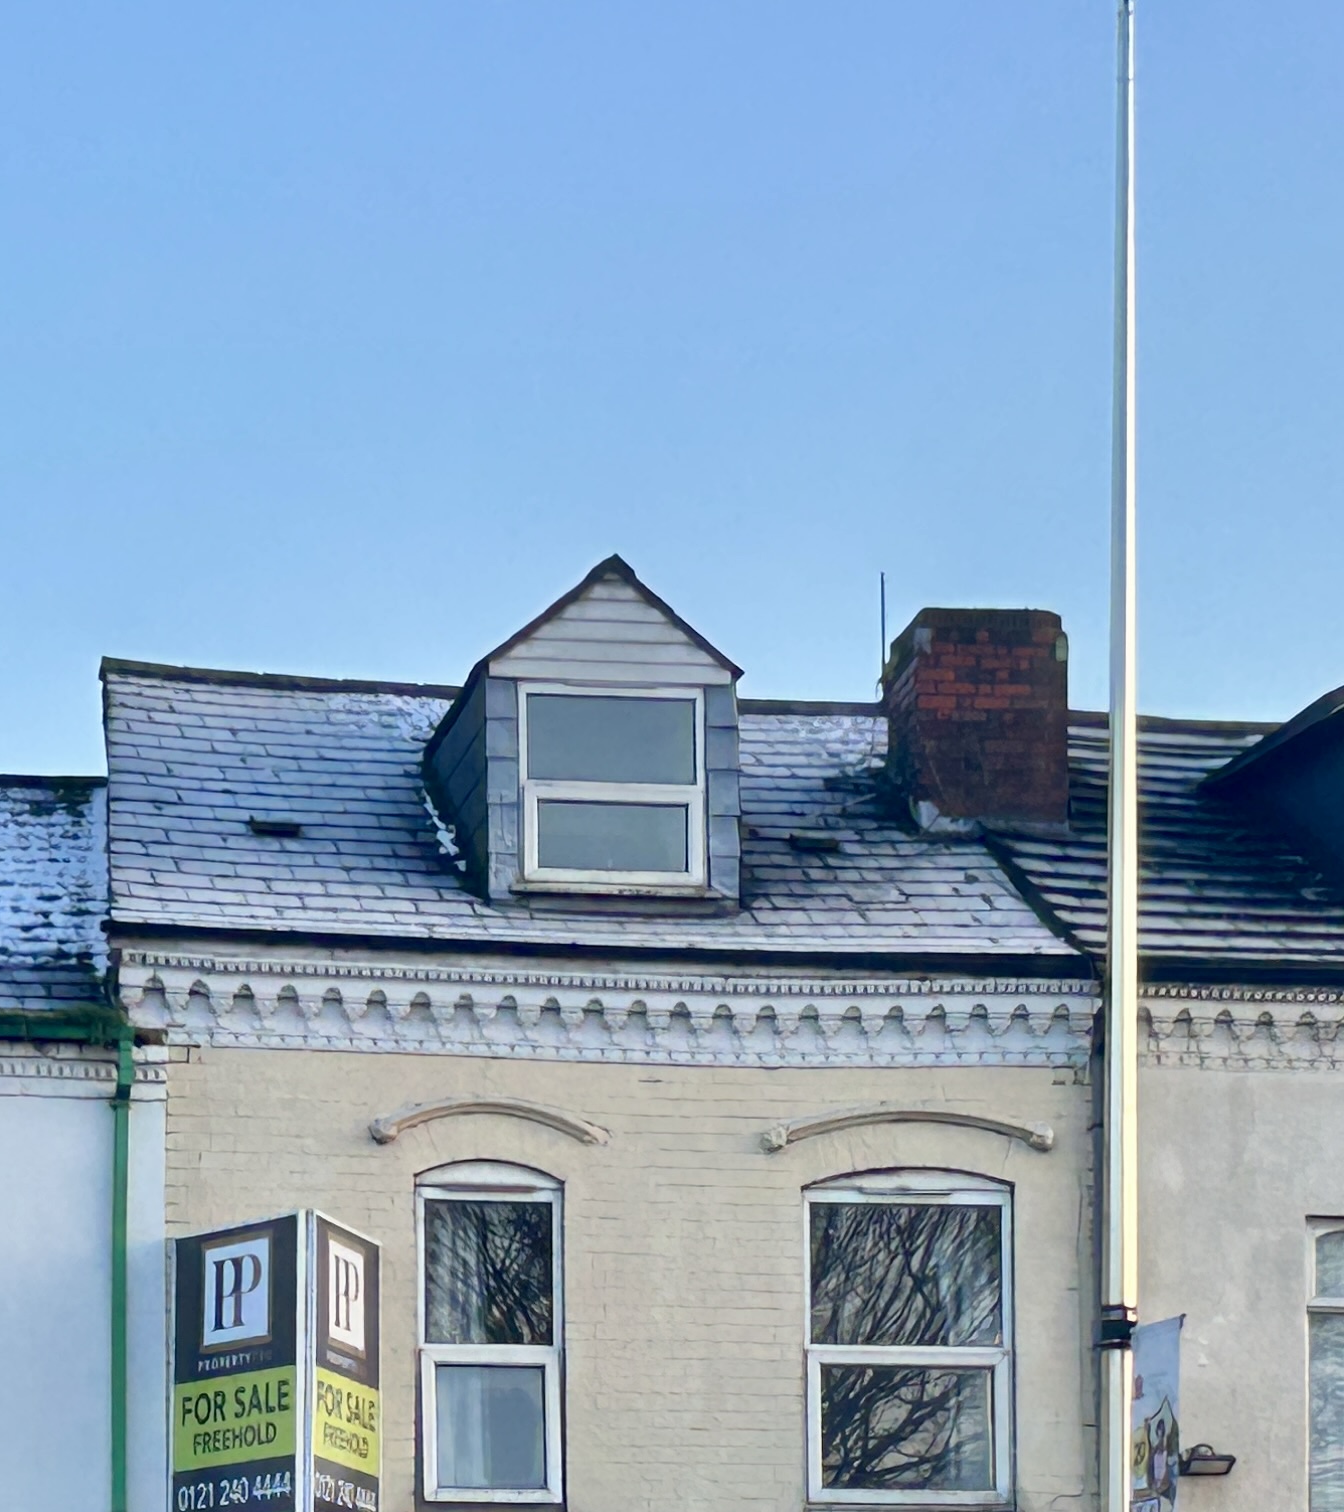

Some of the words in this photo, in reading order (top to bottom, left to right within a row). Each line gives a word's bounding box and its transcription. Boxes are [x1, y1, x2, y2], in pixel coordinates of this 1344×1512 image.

[182, 1390, 226, 1427] FOR
[234, 1380, 290, 1419] SALE
[316, 1380, 343, 1420] FOR
[193, 1422, 278, 1456] FREEHOLD
[178, 1482, 214, 1512] 0121
